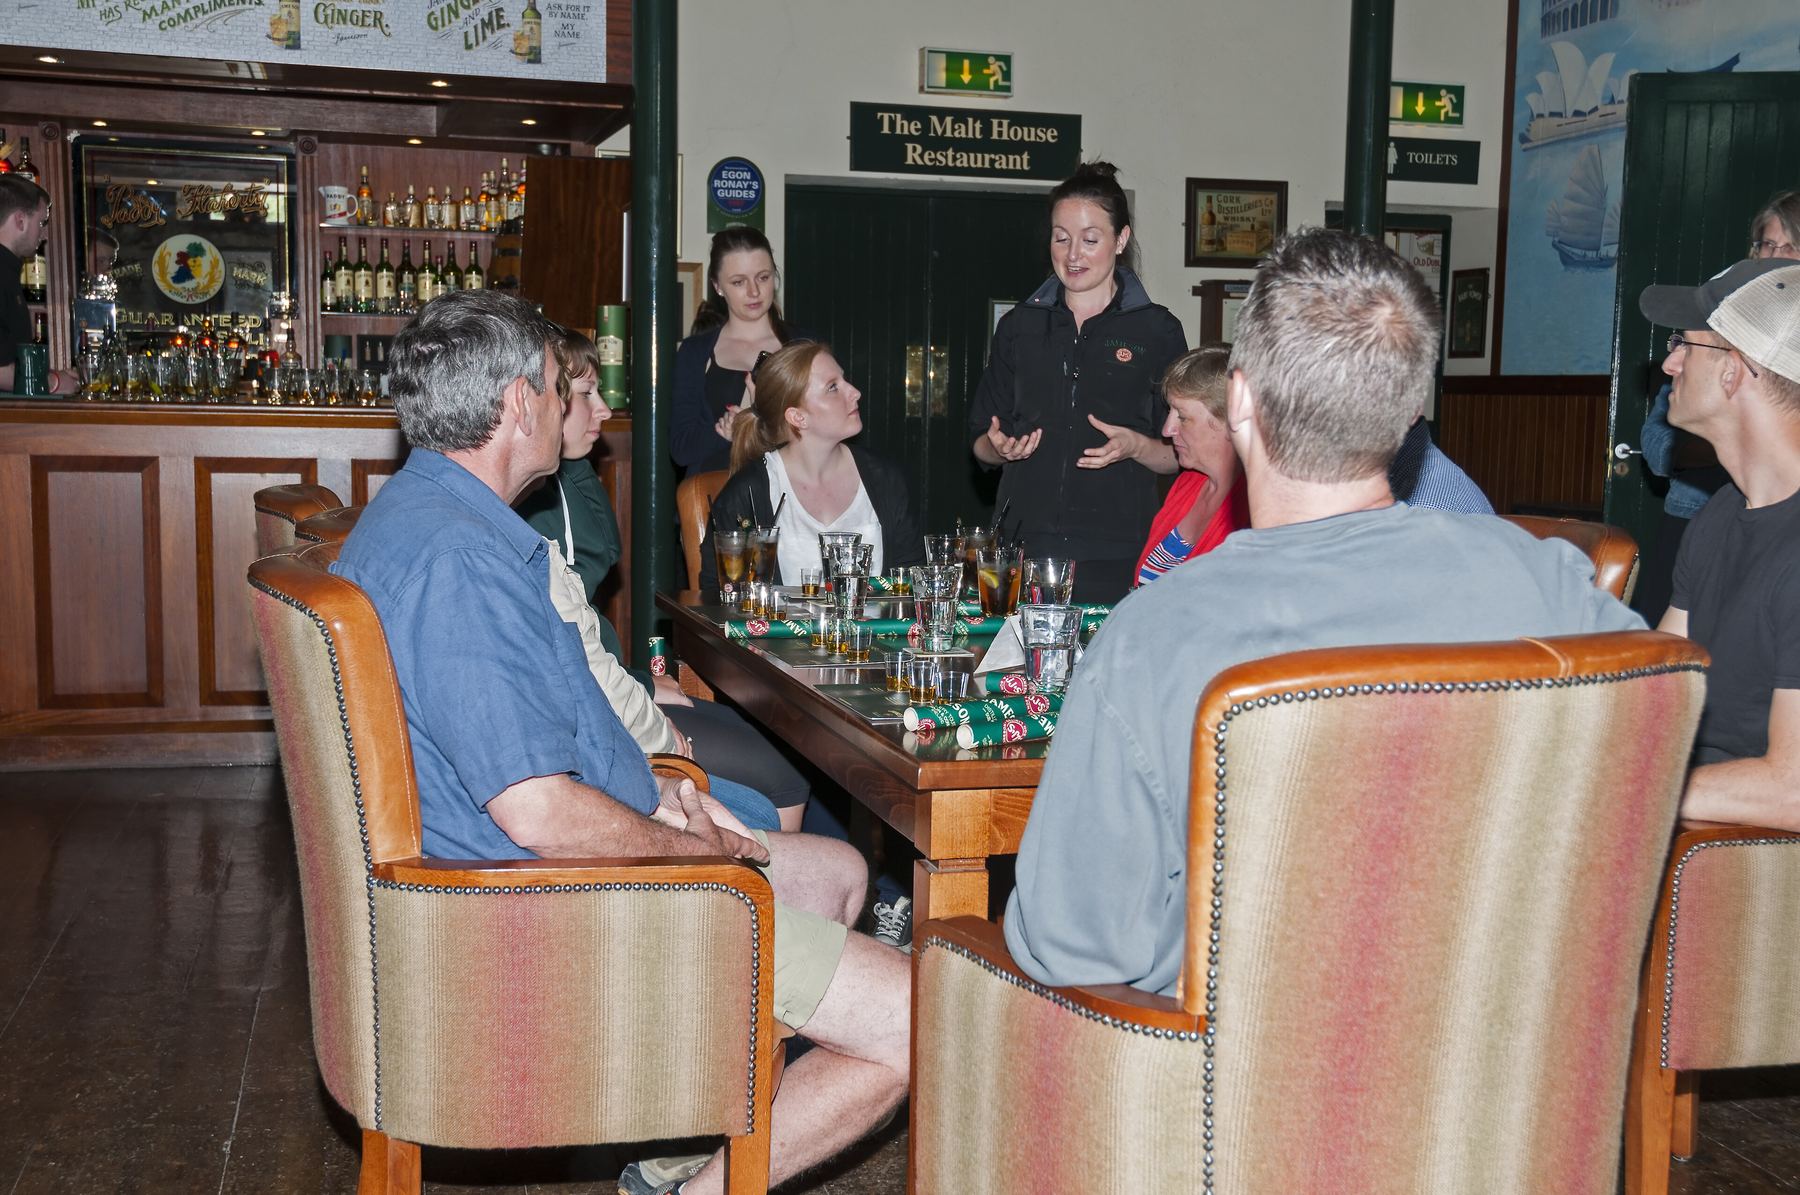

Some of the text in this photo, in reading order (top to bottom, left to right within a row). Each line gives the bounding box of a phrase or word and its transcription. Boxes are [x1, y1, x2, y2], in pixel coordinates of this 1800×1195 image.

[546, 3, 563, 11] ASK
[566, 4, 581, 12] FOR
[99, 5, 123, 26] HAS
[313, 2, 392, 37] GINGER.
[877, 112, 1059, 143] The Malt House
[904, 143, 1031, 171] Restaurant
[1406, 151, 1458, 166] TOILETS
[721, 170, 751, 180] EGON
[713, 180, 759, 190] RONAY'S
[717, 189, 756, 199] GUIDES
[1216, 194, 1241, 204] CORK
[1223, 215, 1257, 223] WHISKY
